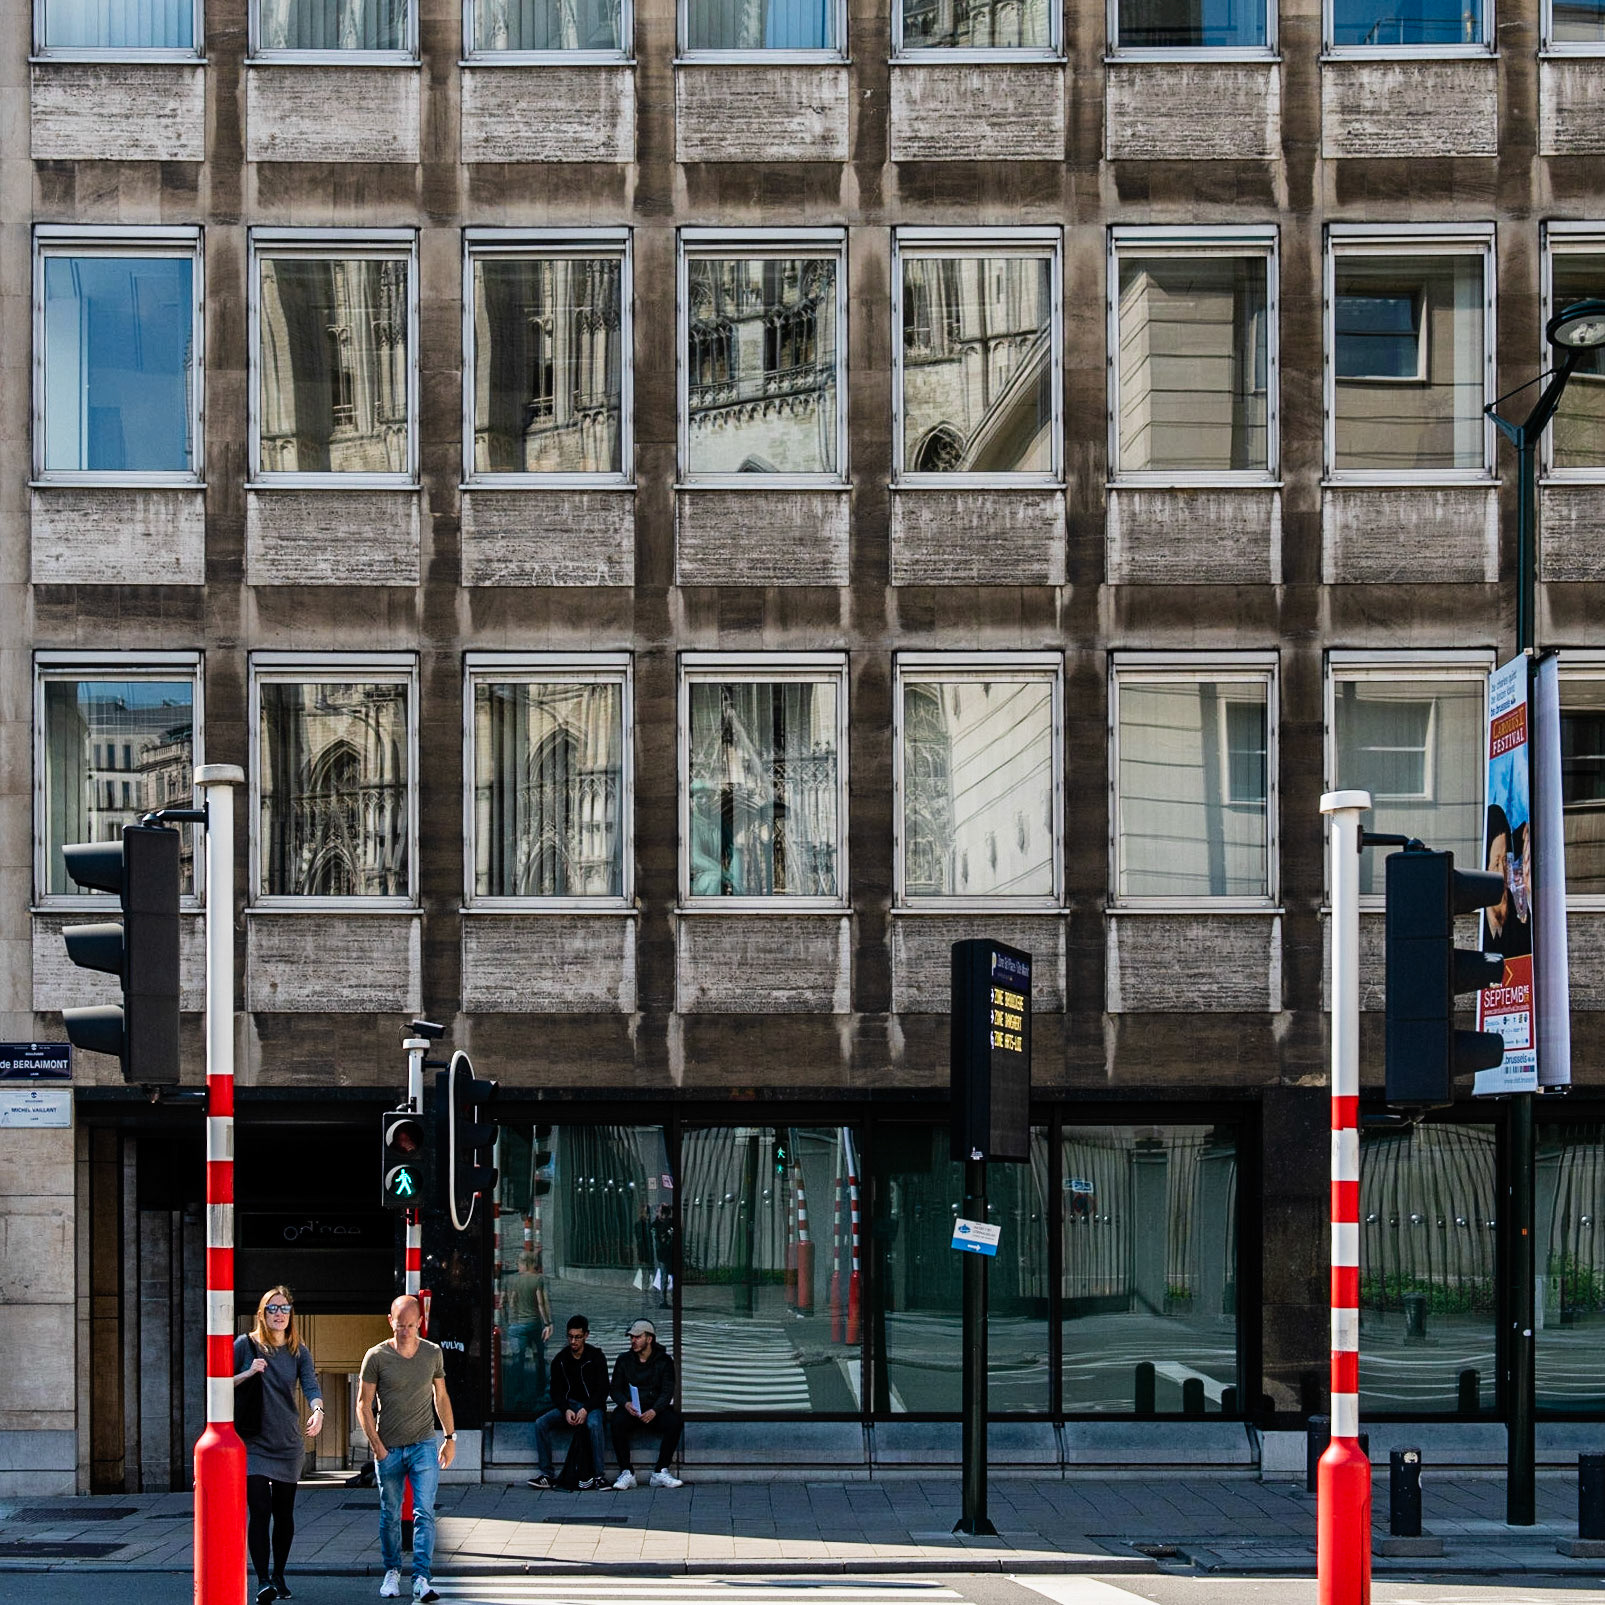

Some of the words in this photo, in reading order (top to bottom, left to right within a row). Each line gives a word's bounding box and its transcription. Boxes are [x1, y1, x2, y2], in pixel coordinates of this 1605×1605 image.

[1492, 727, 1525, 756] FESTIVAL
[0, 1060, 11, 1069] de
[13, 1060, 68, 1069] BERLAIMONT
